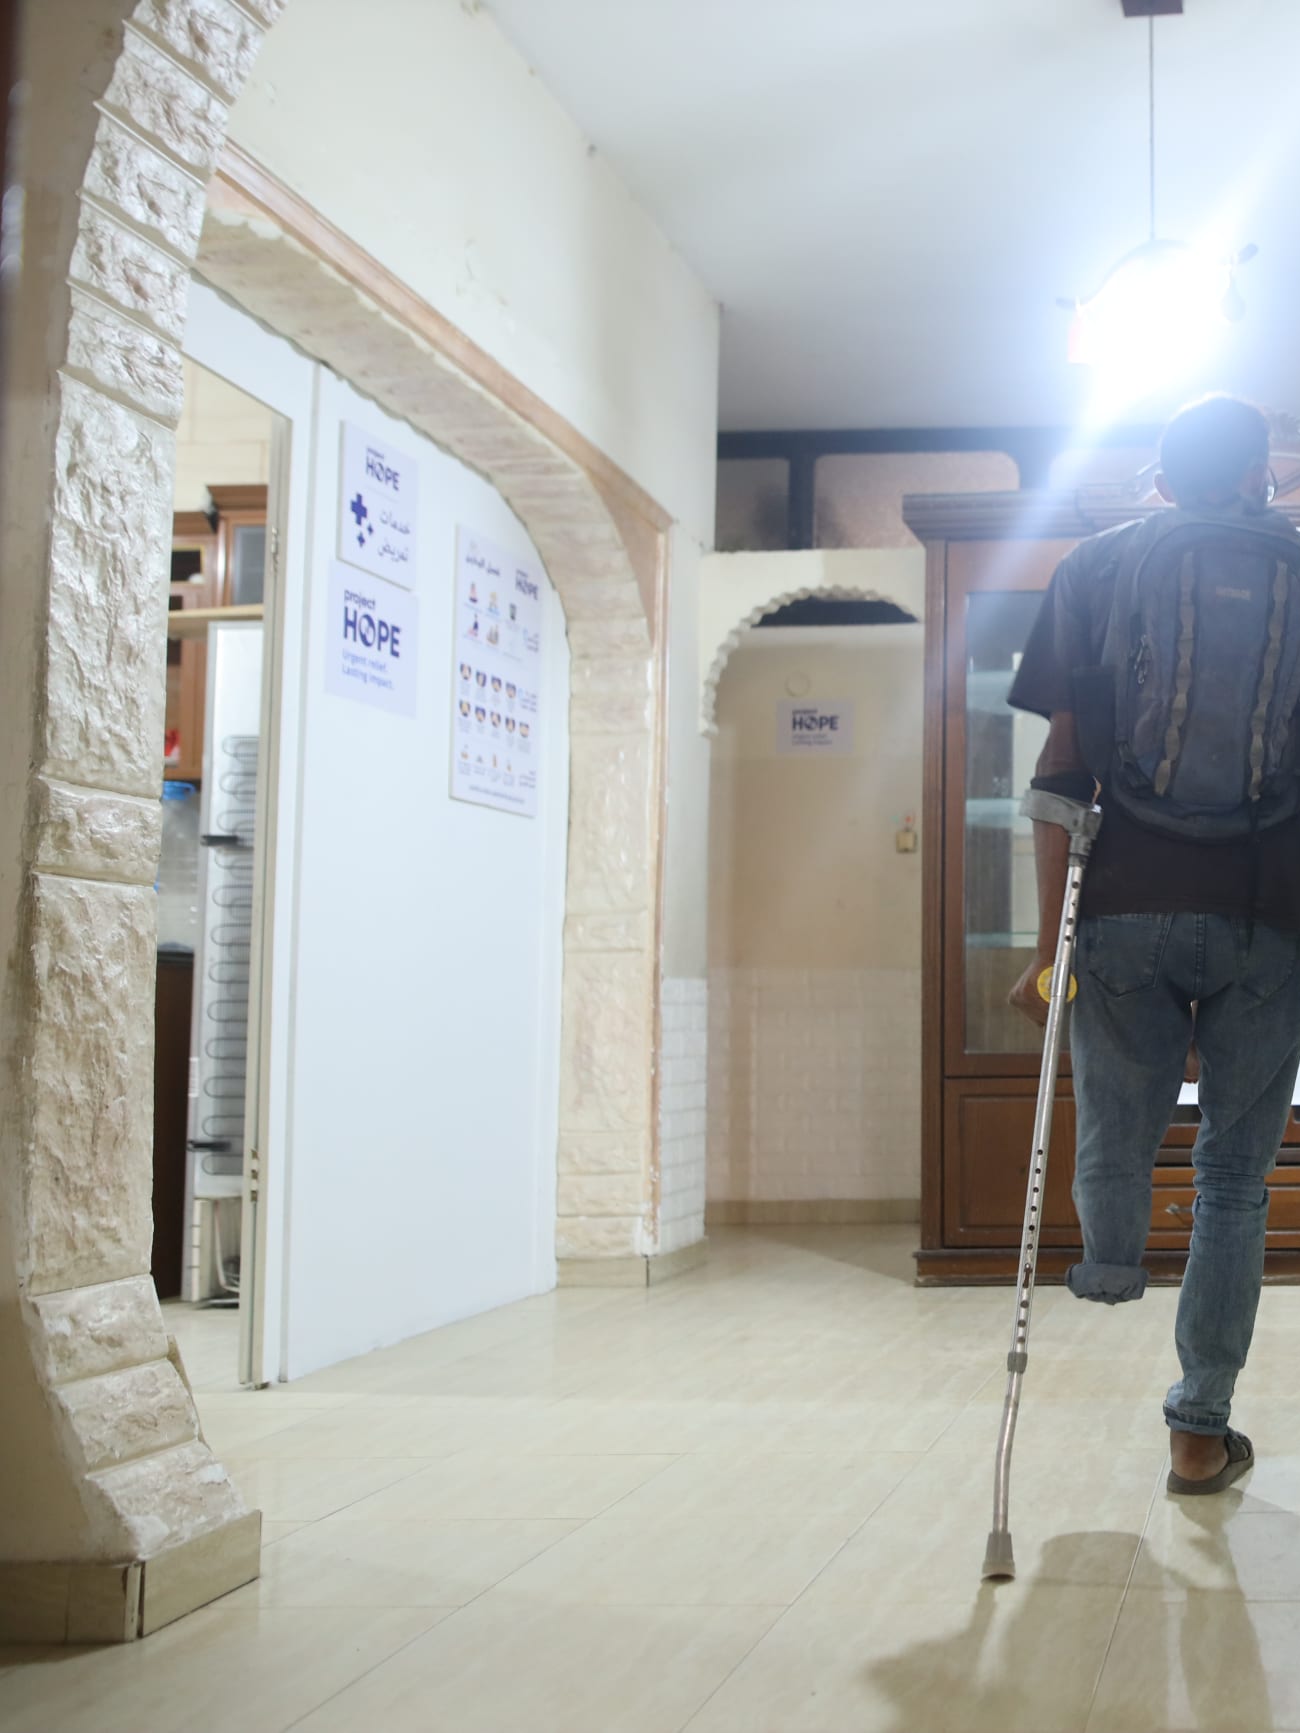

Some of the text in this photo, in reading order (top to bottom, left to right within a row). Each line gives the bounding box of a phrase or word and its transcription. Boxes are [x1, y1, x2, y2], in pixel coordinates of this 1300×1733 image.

[365, 456, 400, 491] HOPE
[344, 589, 376, 610] project
[344, 605, 401, 658] HOPE
[791, 715, 840, 731] HOPE
